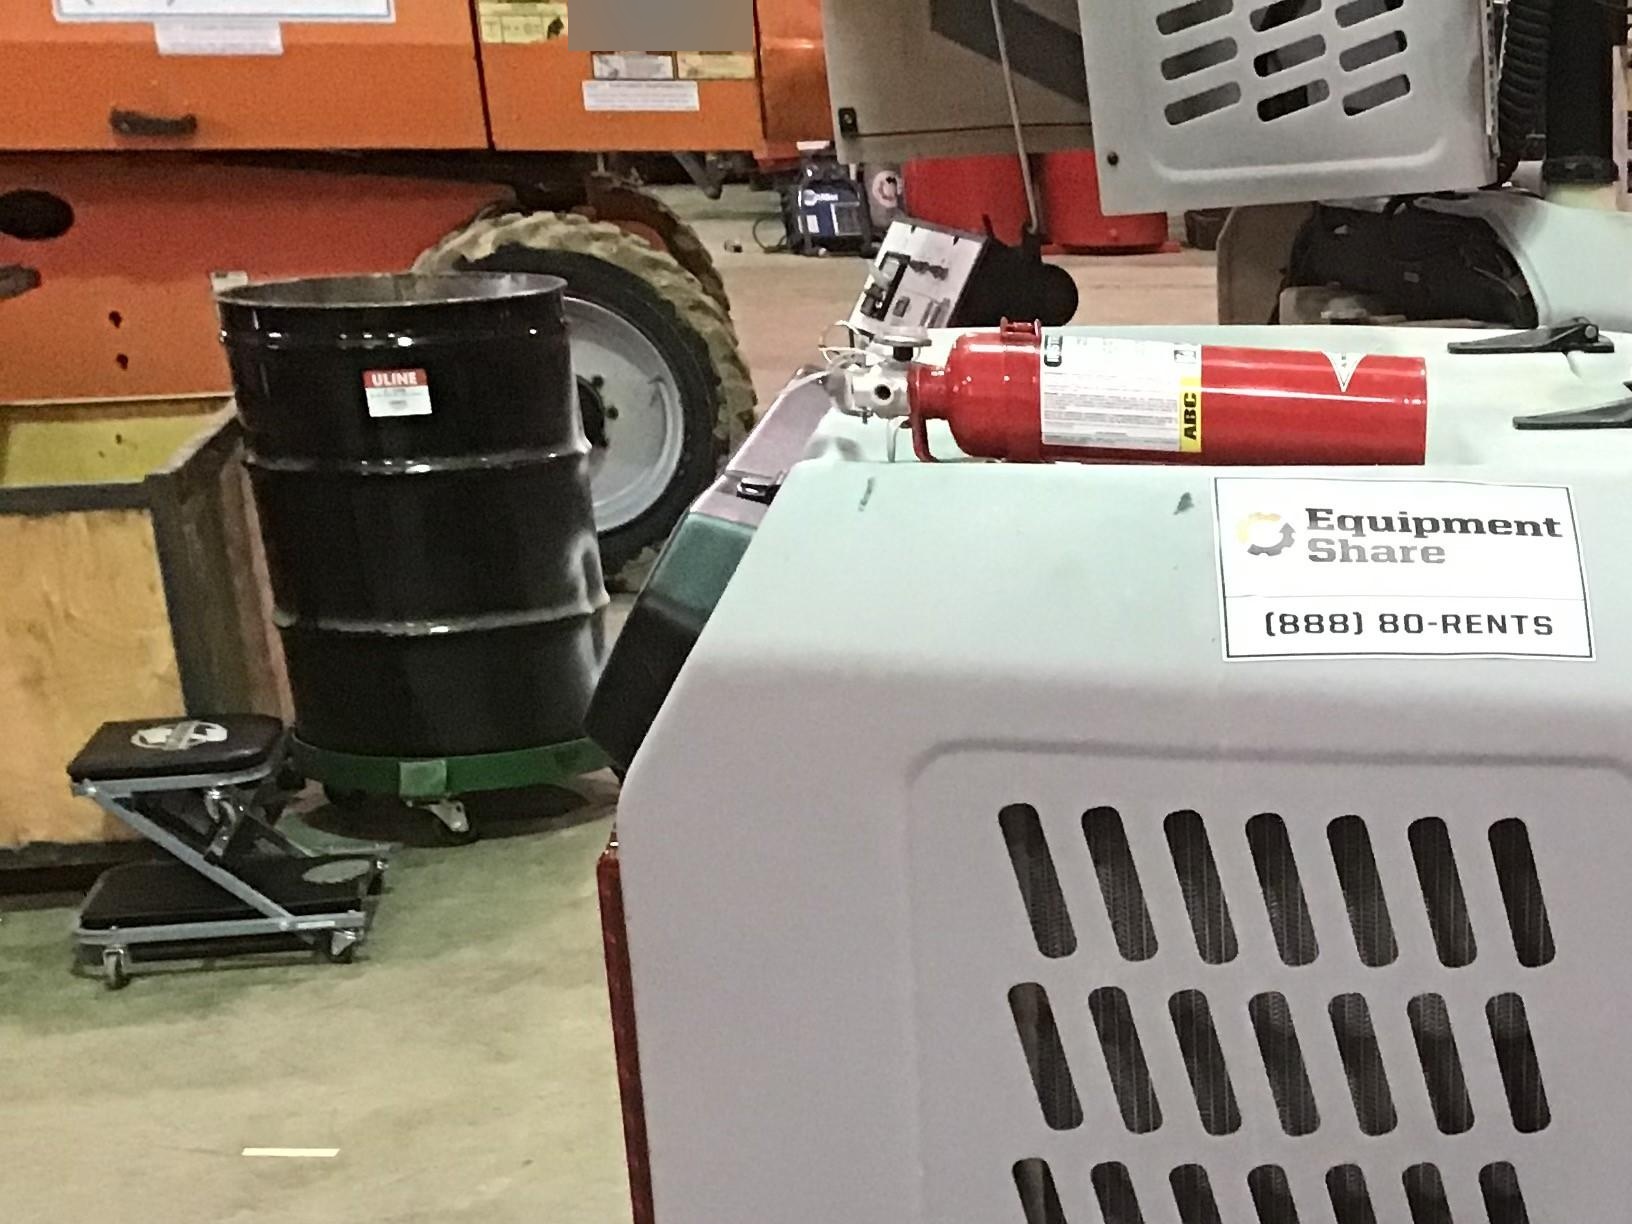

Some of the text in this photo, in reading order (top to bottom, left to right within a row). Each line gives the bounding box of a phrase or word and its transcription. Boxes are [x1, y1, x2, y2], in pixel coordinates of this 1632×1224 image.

[371, 372, 418, 386] ULINE
[1183, 392, 1197, 440] ABC
[1305, 507, 1563, 539] Equipment
[1307, 538, 1446, 564] Share
[1265, 612, 1553, 637] (888) 80-RENTS
